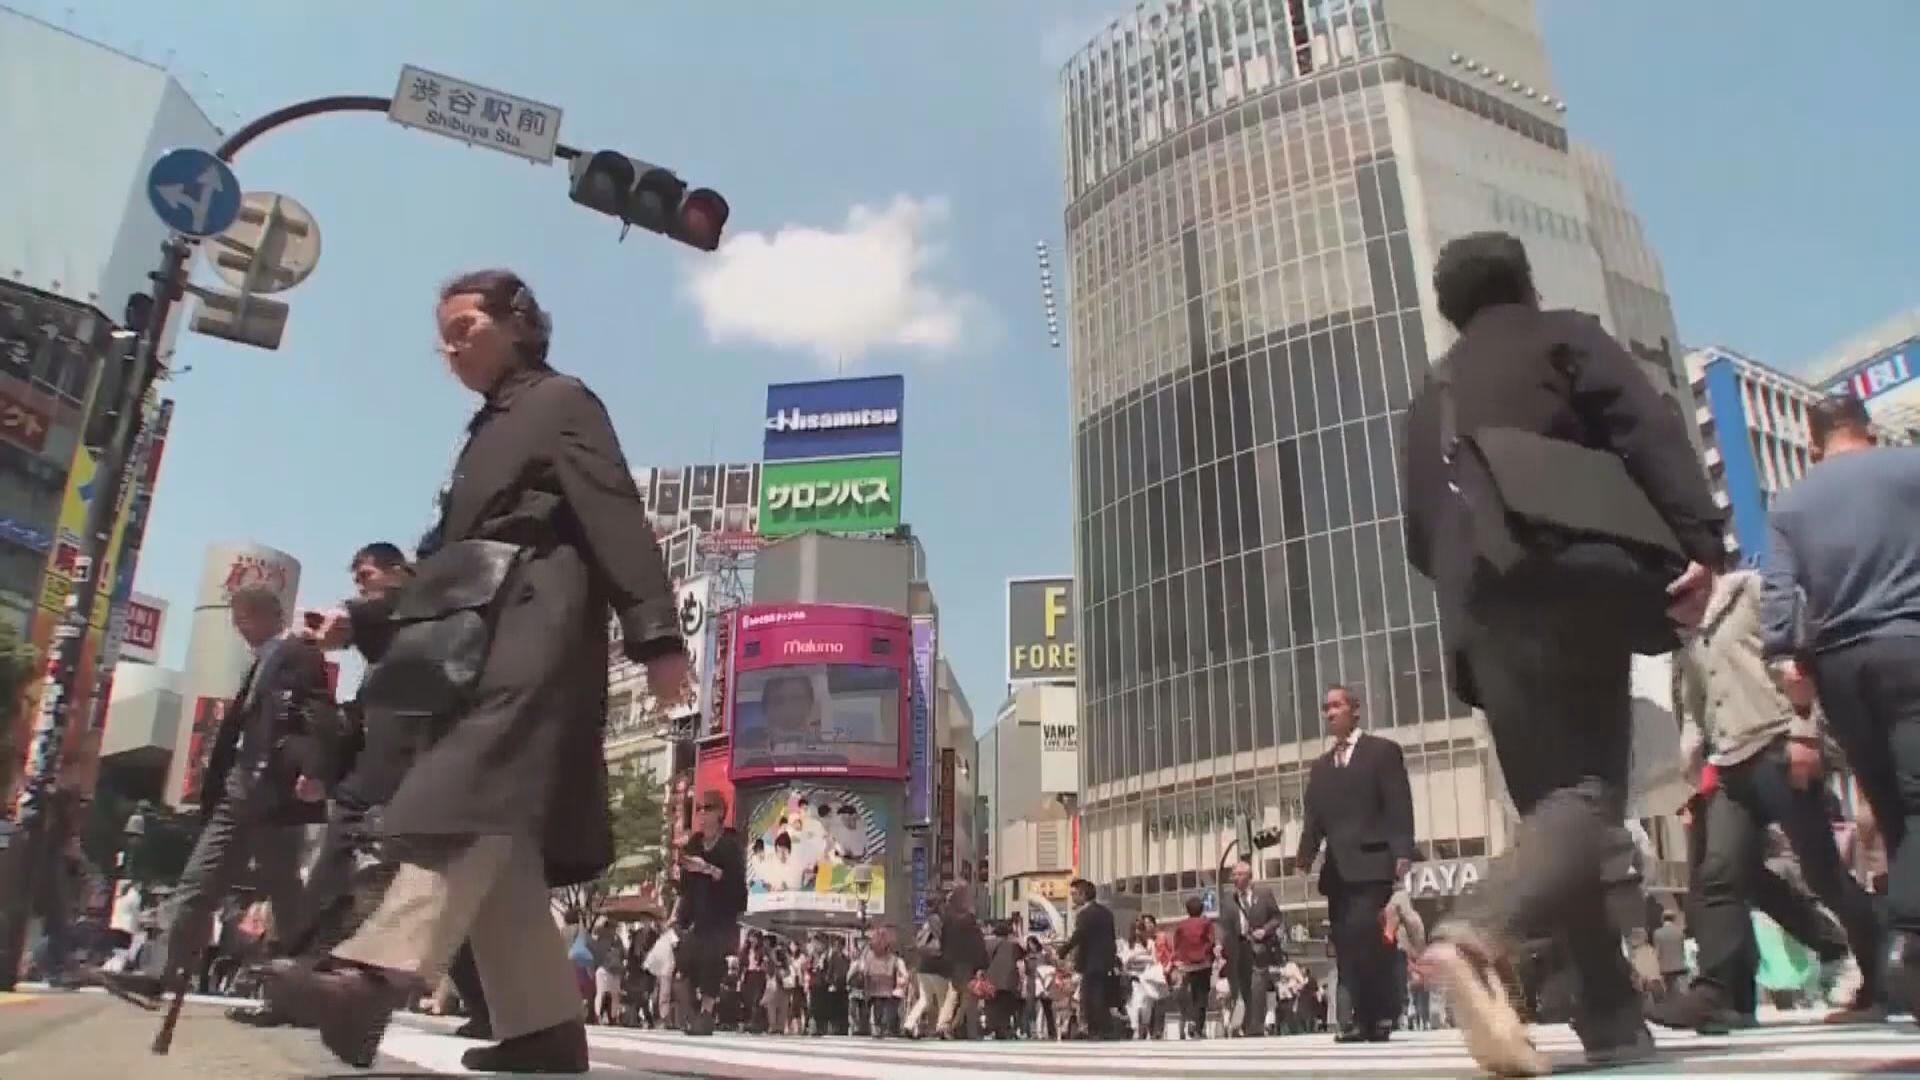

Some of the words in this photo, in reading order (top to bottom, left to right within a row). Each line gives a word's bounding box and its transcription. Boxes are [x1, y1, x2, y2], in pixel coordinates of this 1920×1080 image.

[410, 76, 547, 137] 渋谷駅前
[425, 109, 489, 140] Shibuya
[766, 407, 897, 431] Hisamitsu
[767, 477, 891, 511] サロンパス
[1045, 586, 1067, 638] F
[1014, 642, 1076, 670] FORE
[1043, 725, 1077, 739] VAMP
